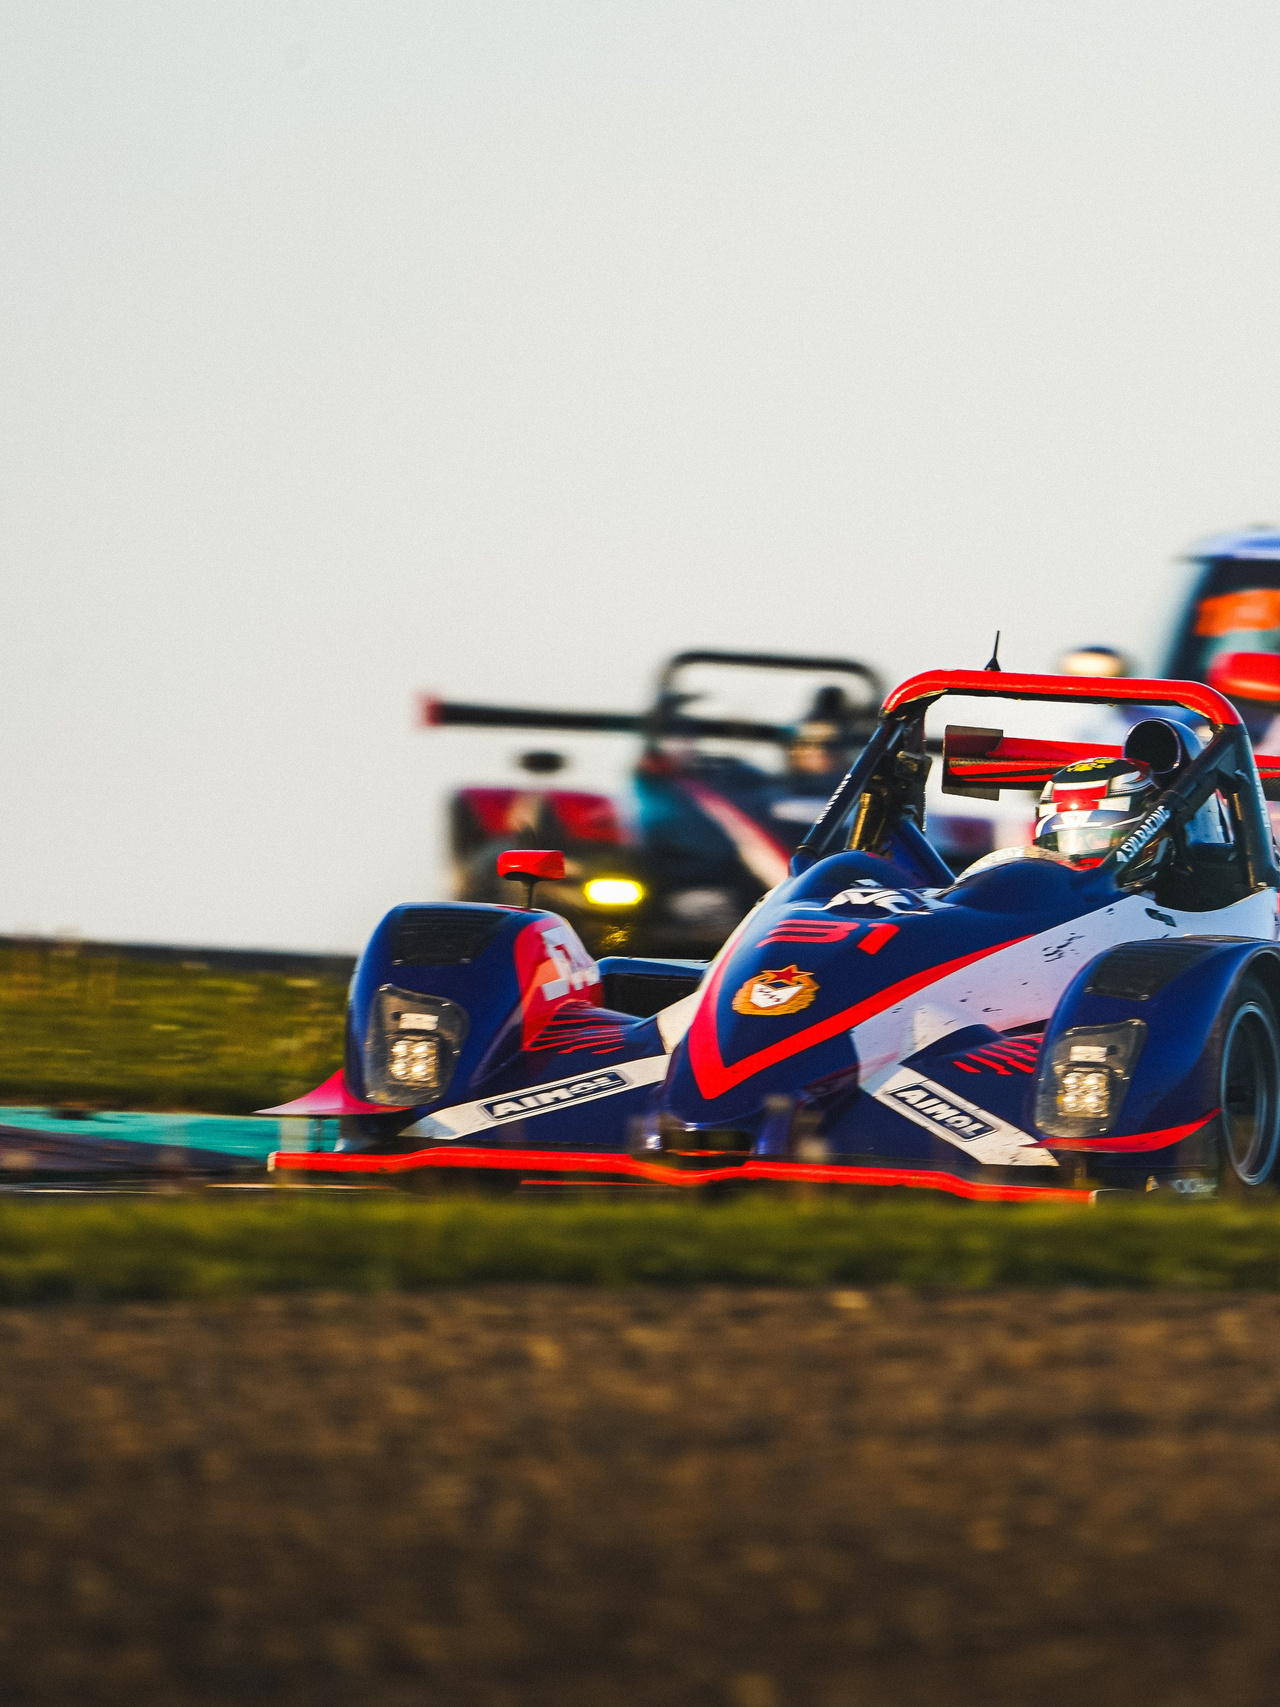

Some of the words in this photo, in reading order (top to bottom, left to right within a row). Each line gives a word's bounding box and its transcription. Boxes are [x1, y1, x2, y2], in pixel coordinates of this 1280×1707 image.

[756, 919, 900, 955] 31
[492, 1076, 622, 1117] AIMOL
[895, 1089, 985, 1136] AIMOL
